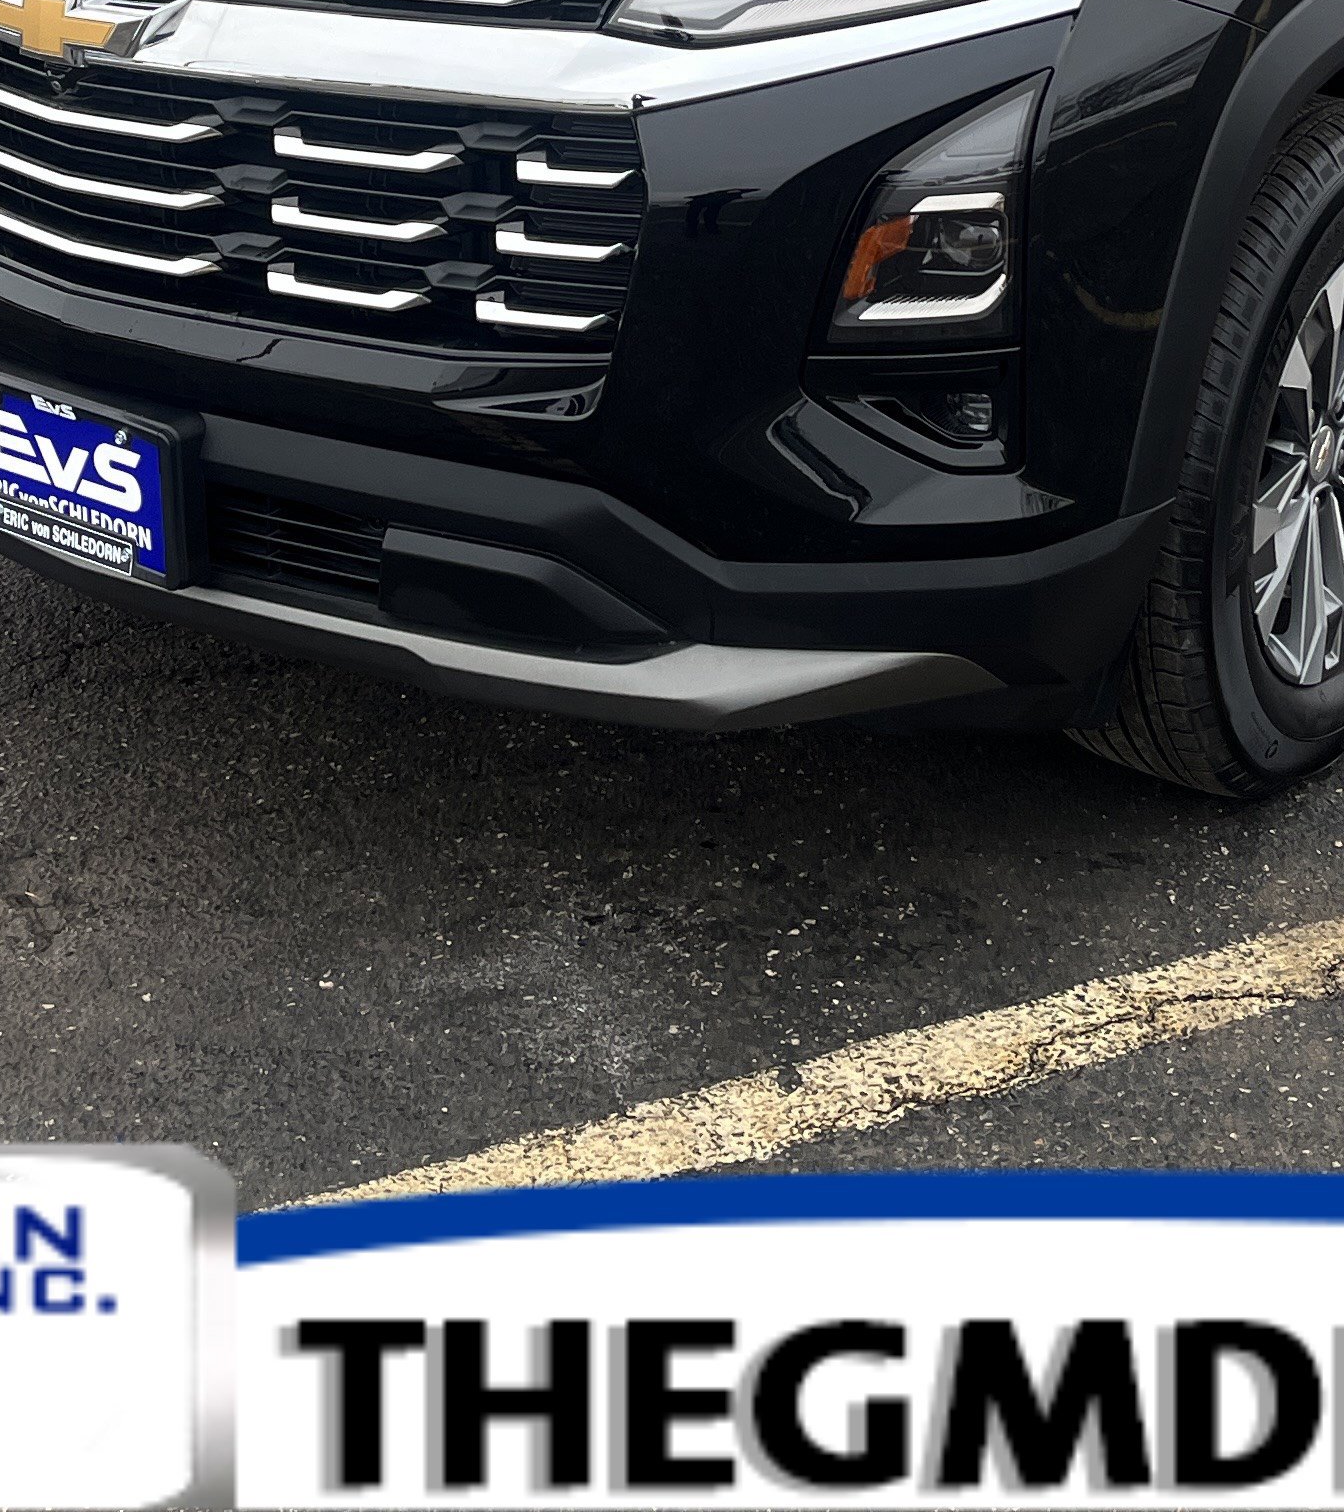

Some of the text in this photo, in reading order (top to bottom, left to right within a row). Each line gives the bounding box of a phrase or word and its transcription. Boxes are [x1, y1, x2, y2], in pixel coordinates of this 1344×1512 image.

[3, 507, 122, 565] ERIC von SCHLEDORN
